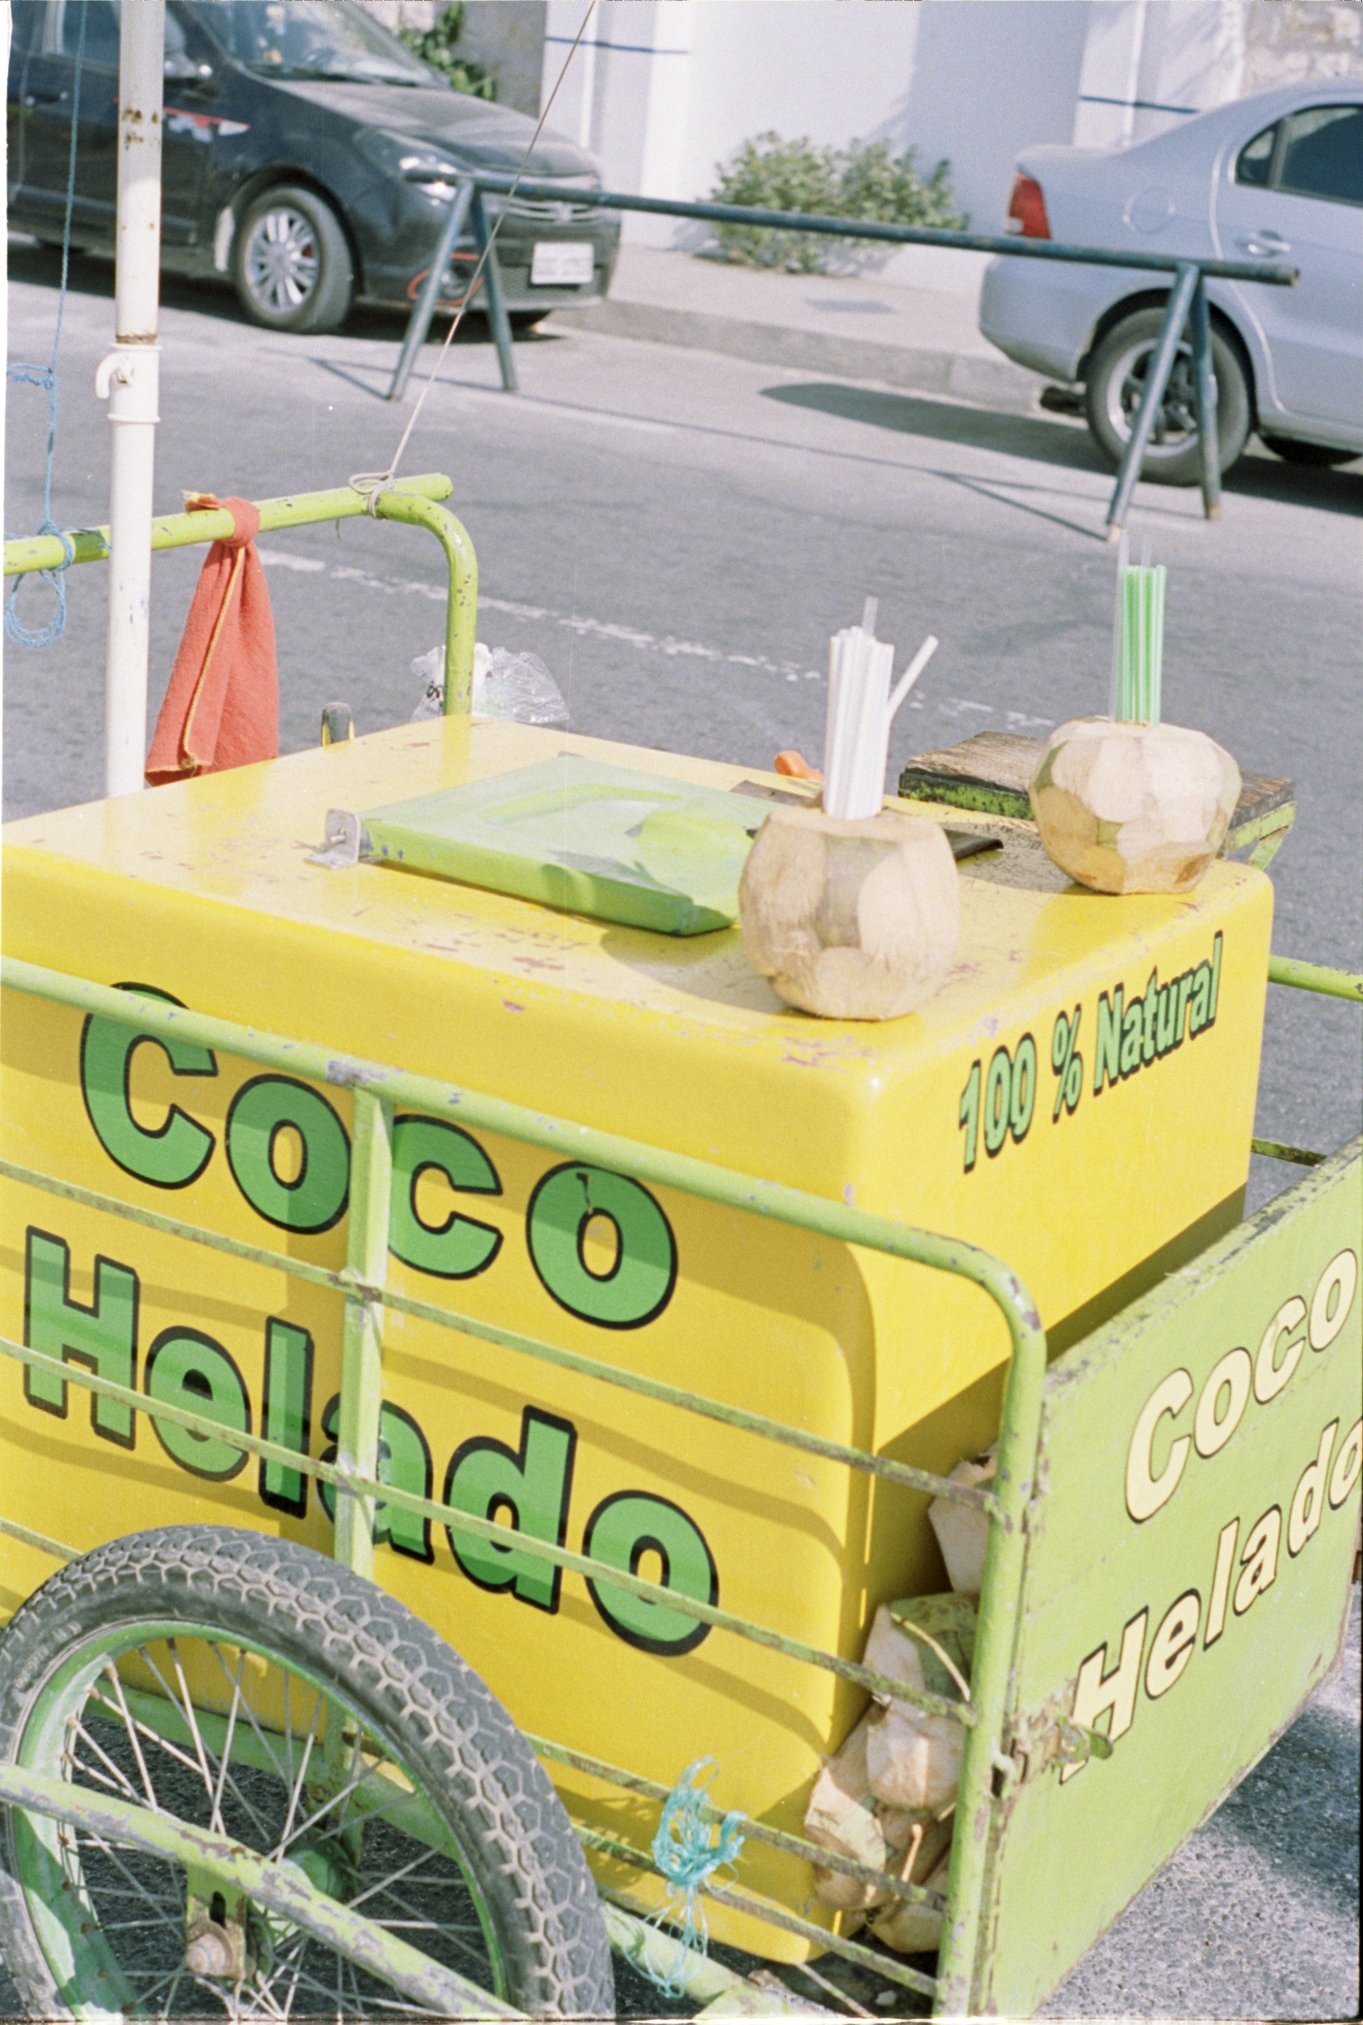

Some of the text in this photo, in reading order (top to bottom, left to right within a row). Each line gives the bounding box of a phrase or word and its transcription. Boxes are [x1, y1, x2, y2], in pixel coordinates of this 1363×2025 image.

[80, 981, 678, 1330] Coco
[959, 929, 1223, 1175] 100 % Natural
[24, 1225, 719, 1656] Helado
[1125, 1248, 1358, 1523] Coco
[1059, 1416, 1362, 1786] Helado
